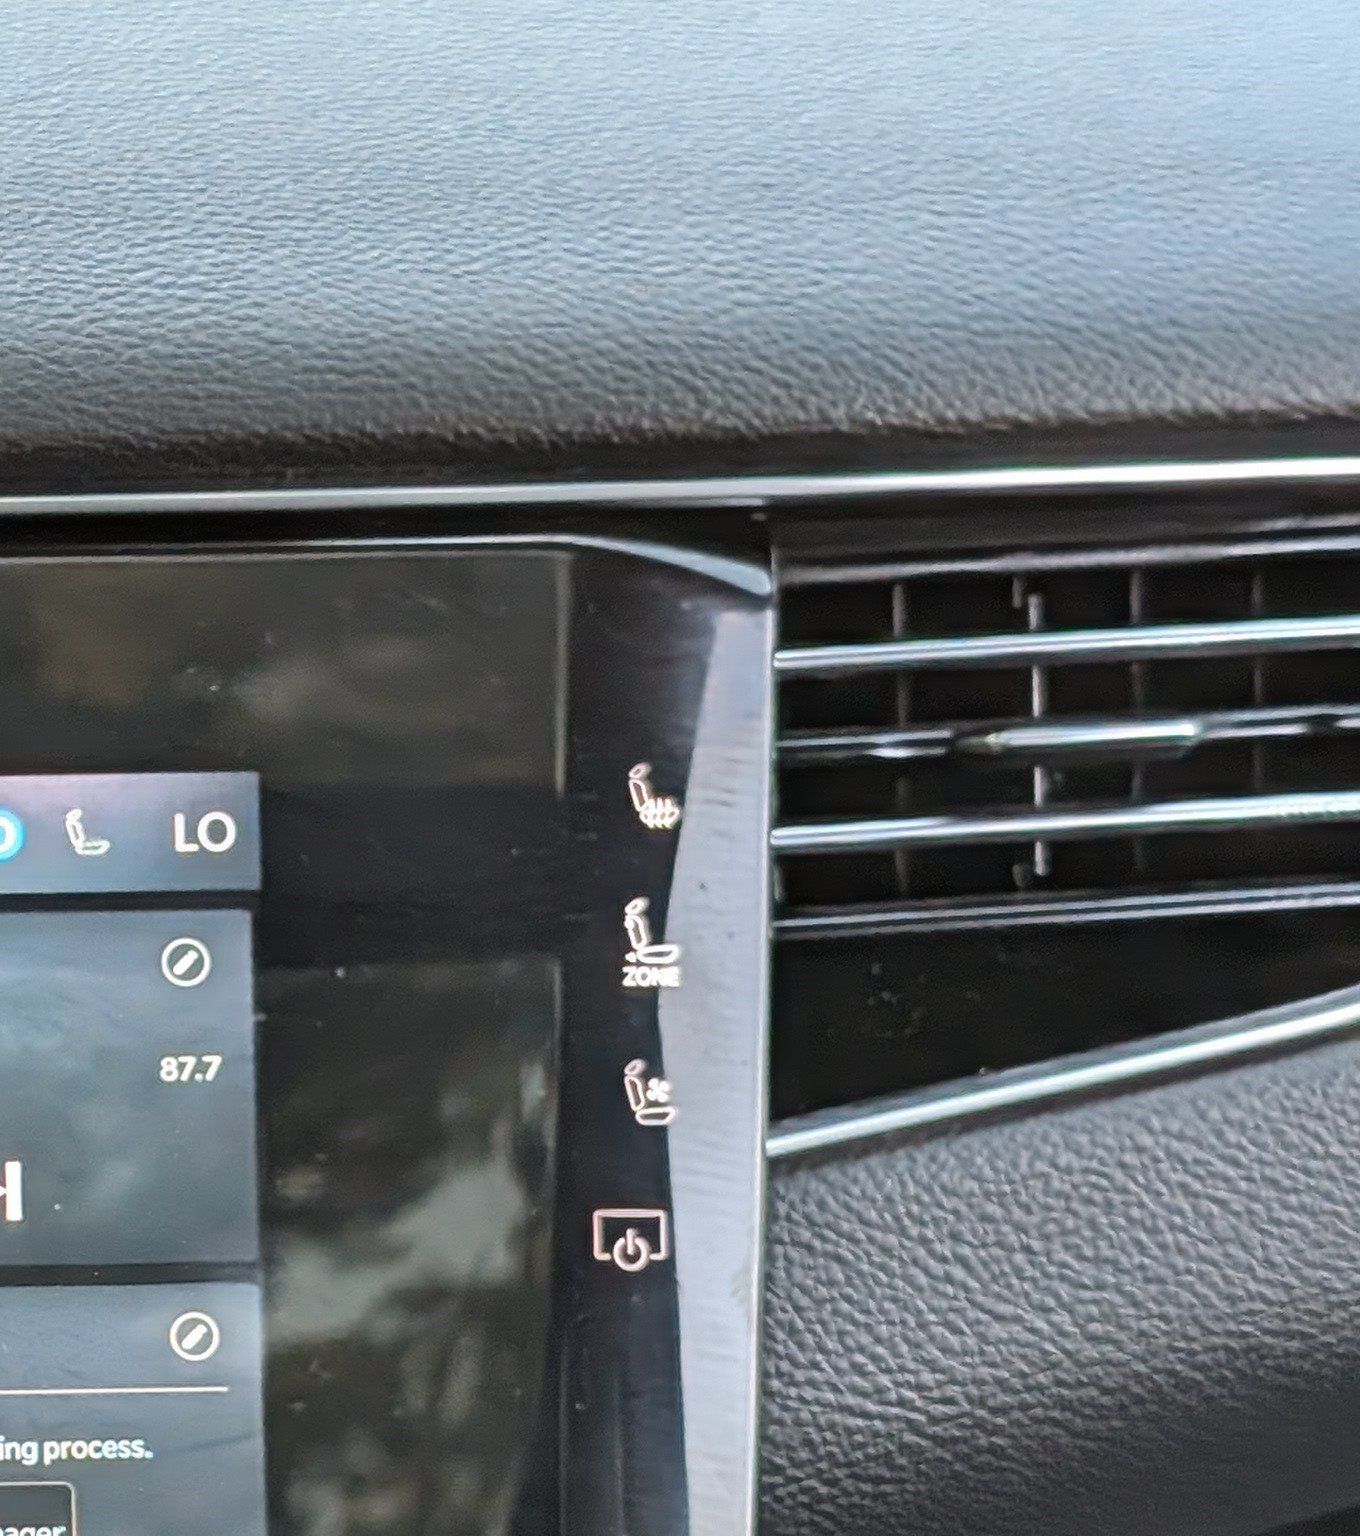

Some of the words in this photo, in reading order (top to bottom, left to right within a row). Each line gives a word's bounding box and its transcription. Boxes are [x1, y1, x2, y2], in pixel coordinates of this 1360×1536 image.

[172, 811, 236, 853] LO
[623, 967, 681, 987] ZONE
[159, 1054, 223, 1085] 87.7
[43, 1438, 154, 1466] process.
